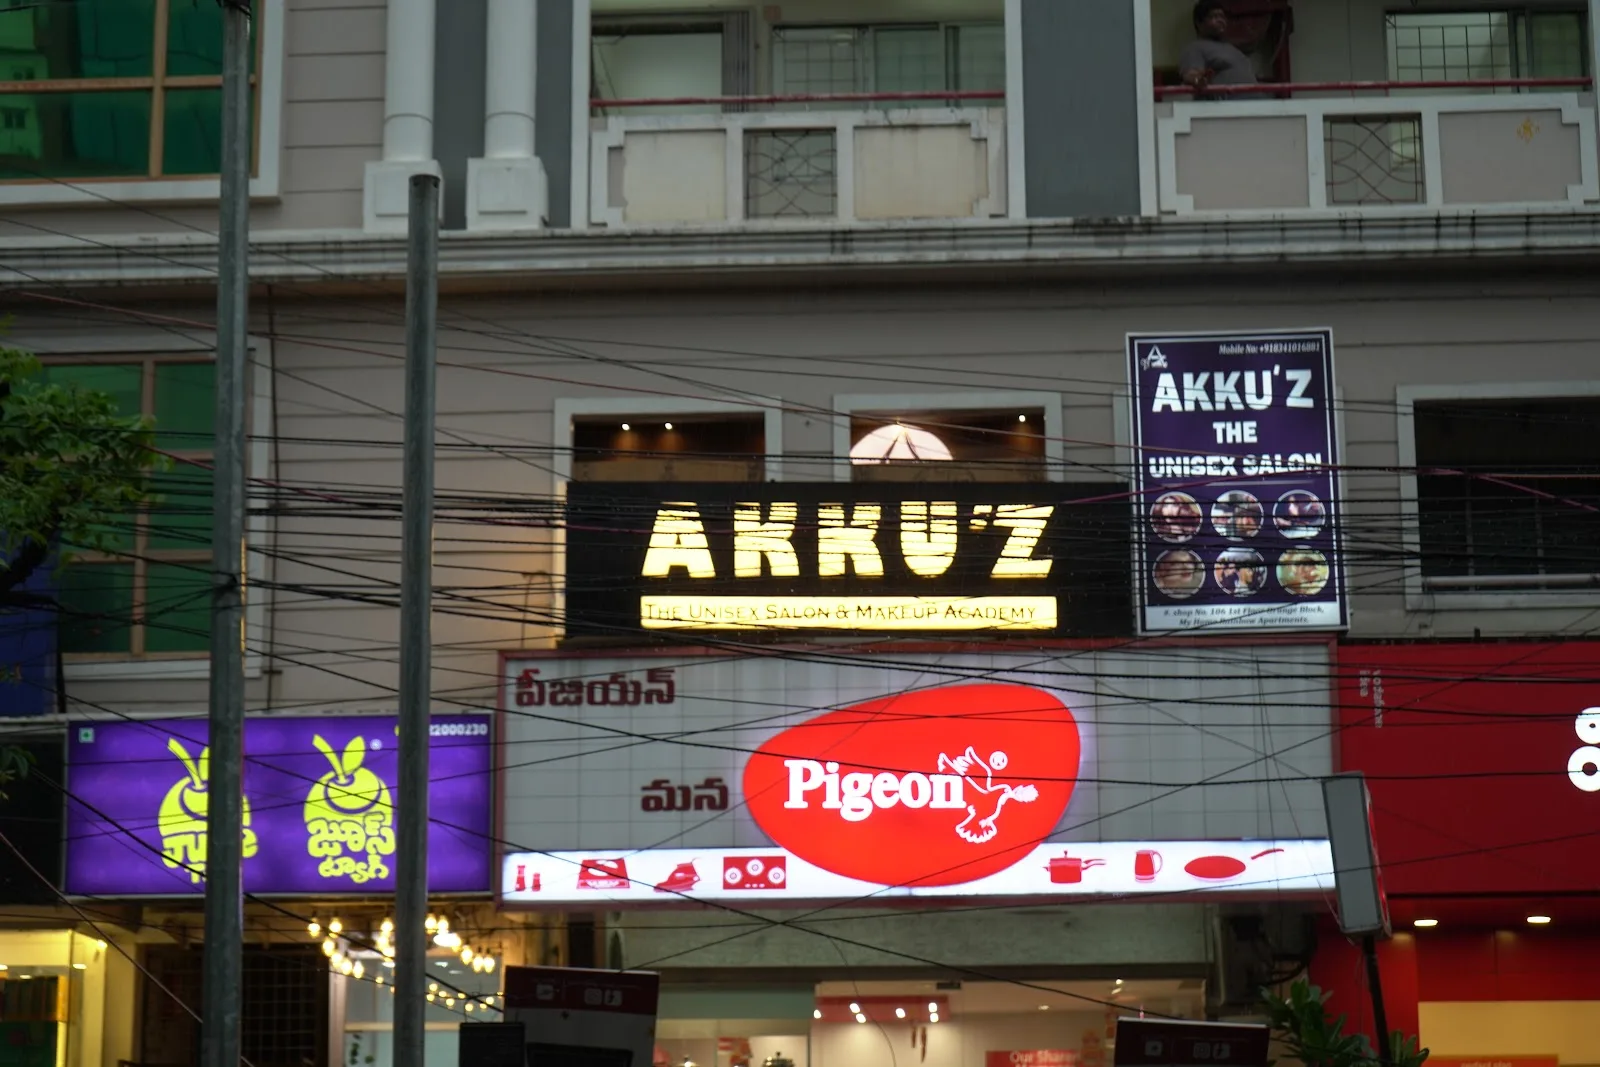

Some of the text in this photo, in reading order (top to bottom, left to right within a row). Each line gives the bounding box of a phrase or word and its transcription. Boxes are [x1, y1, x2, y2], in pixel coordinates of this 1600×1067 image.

[1219, 344, 1244, 355] Mobile
[1152, 364, 1314, 412] AKKU'Z
[1213, 421, 1258, 444] THE
[1149, 453, 1322, 478] UNISEX SALON
[641, 501, 1055, 578] AKKU'Z
[766, 604, 830, 619] SALON
[836, 604, 849, 619] &
[857, 605, 938, 619] MAKEUP
[641, 778, 730, 812] మన
[784, 759, 966, 822] Pigeon
